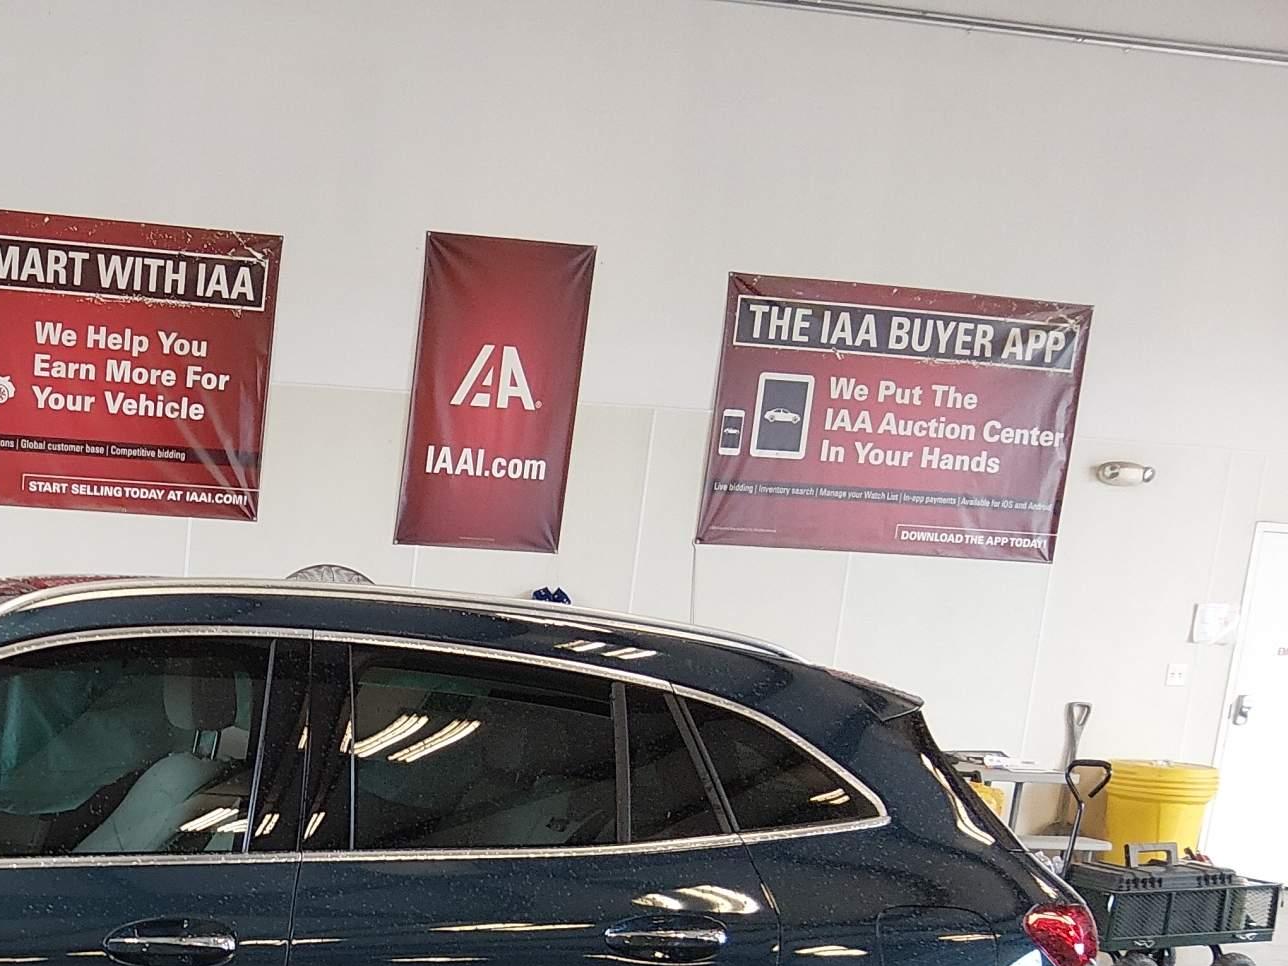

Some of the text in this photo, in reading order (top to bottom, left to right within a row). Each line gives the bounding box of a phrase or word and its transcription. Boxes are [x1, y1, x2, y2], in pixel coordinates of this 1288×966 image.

[97, 254, 186, 295] WITH
[197, 263, 254, 301] IAA
[35, 321, 207, 357] We Help You
[749, 304, 1066, 363] THE IAA BUYER APP
[34, 354, 230, 391] Earn More For
[32, 385, 204, 420] Your Vehicle
[830, 376, 978, 409] We Put The
[824, 408, 1064, 448] IAA Auction Center
[21, 439, 45, 450] Global
[47, 442, 83, 453] customer
[85, 444, 105, 455] base
[110, 445, 155, 459] Competitive
[157, 448, 186, 461] bidding
[425, 445, 546, 481] IAAI.com
[820, 440, 1000, 474] In Your Hands
[28, 481, 247, 506] START SELLING TODAY AT IAAI.COM!
[714, 482, 728, 491] Live
[729, 483, 754, 494] bidding
[759, 484, 791, 496] Inventory
[791, 486, 814, 496] search
[819, 487, 846, 499] Manage
[847, 491, 863, 500] your
[864, 490, 885, 500] Watch
[925, 496, 957, 506] payments
[991, 499, 1000, 508] for
[1014, 501, 1027, 510] and
[901, 530, 1047, 549] DOWNLOAD THE APP TODAY!
